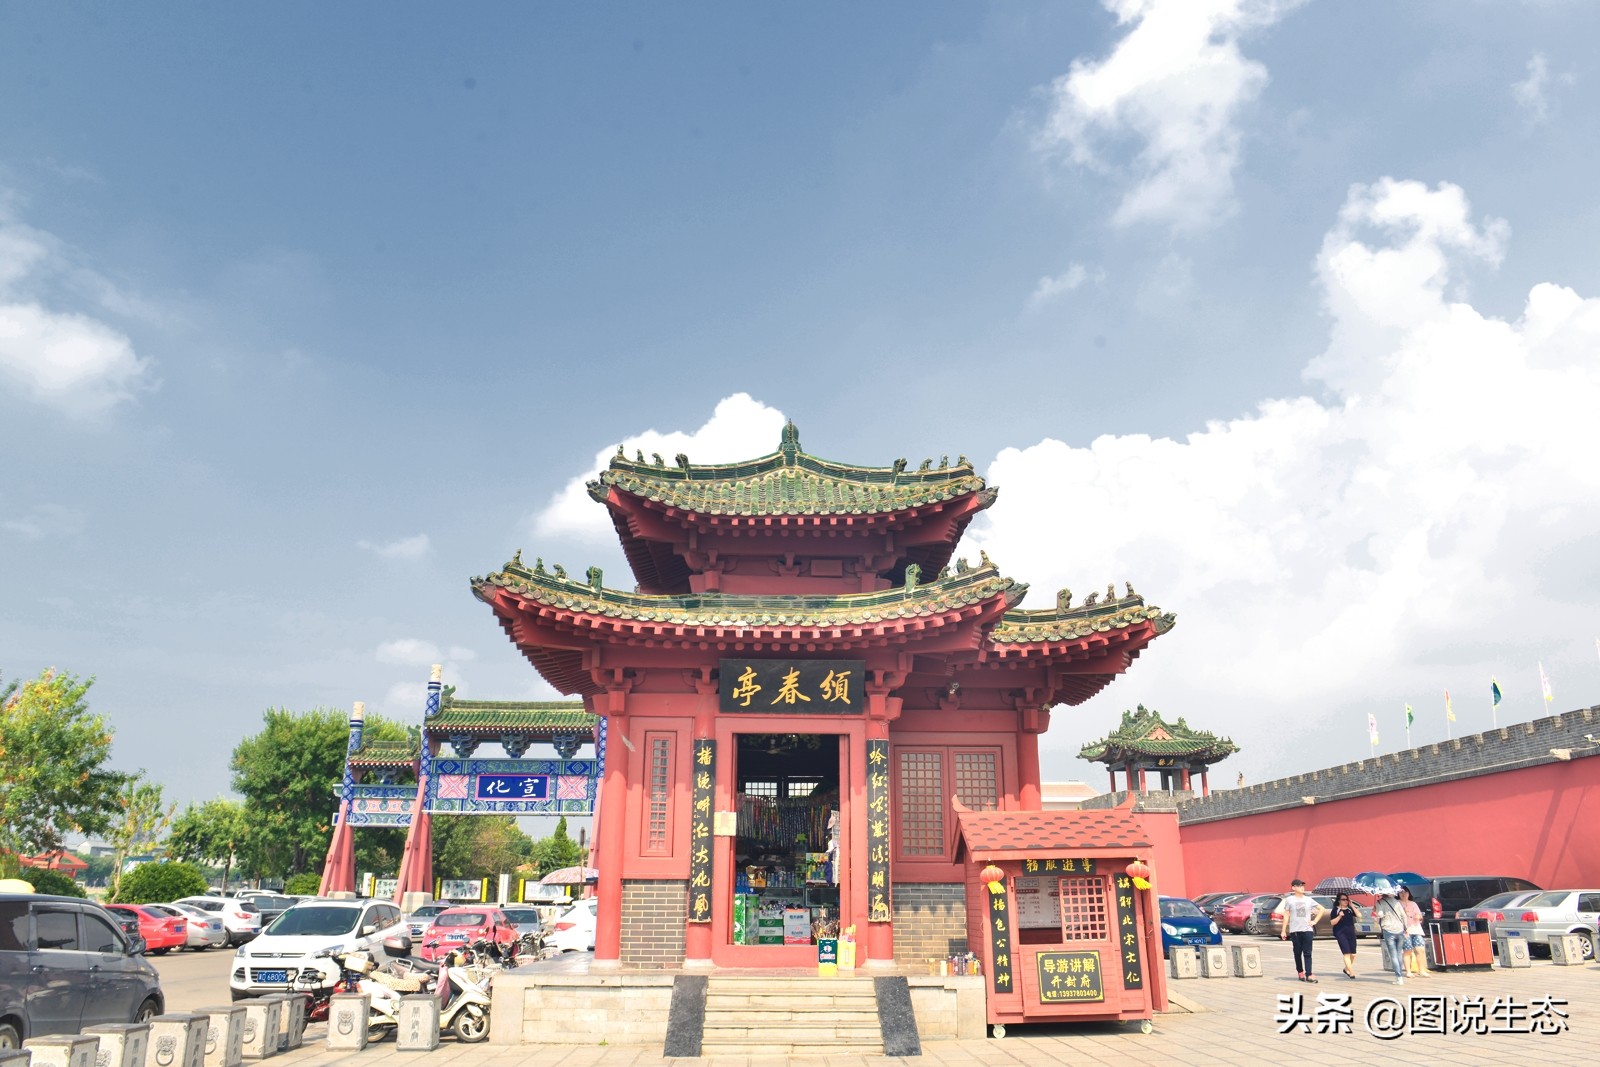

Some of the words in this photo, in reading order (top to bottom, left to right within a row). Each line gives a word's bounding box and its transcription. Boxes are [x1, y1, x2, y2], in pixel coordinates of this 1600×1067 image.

[486, 777, 540, 798] 宣化
[1043, 957, 1096, 974] 导游讲解
[1050, 973, 1091, 989] 开封府
